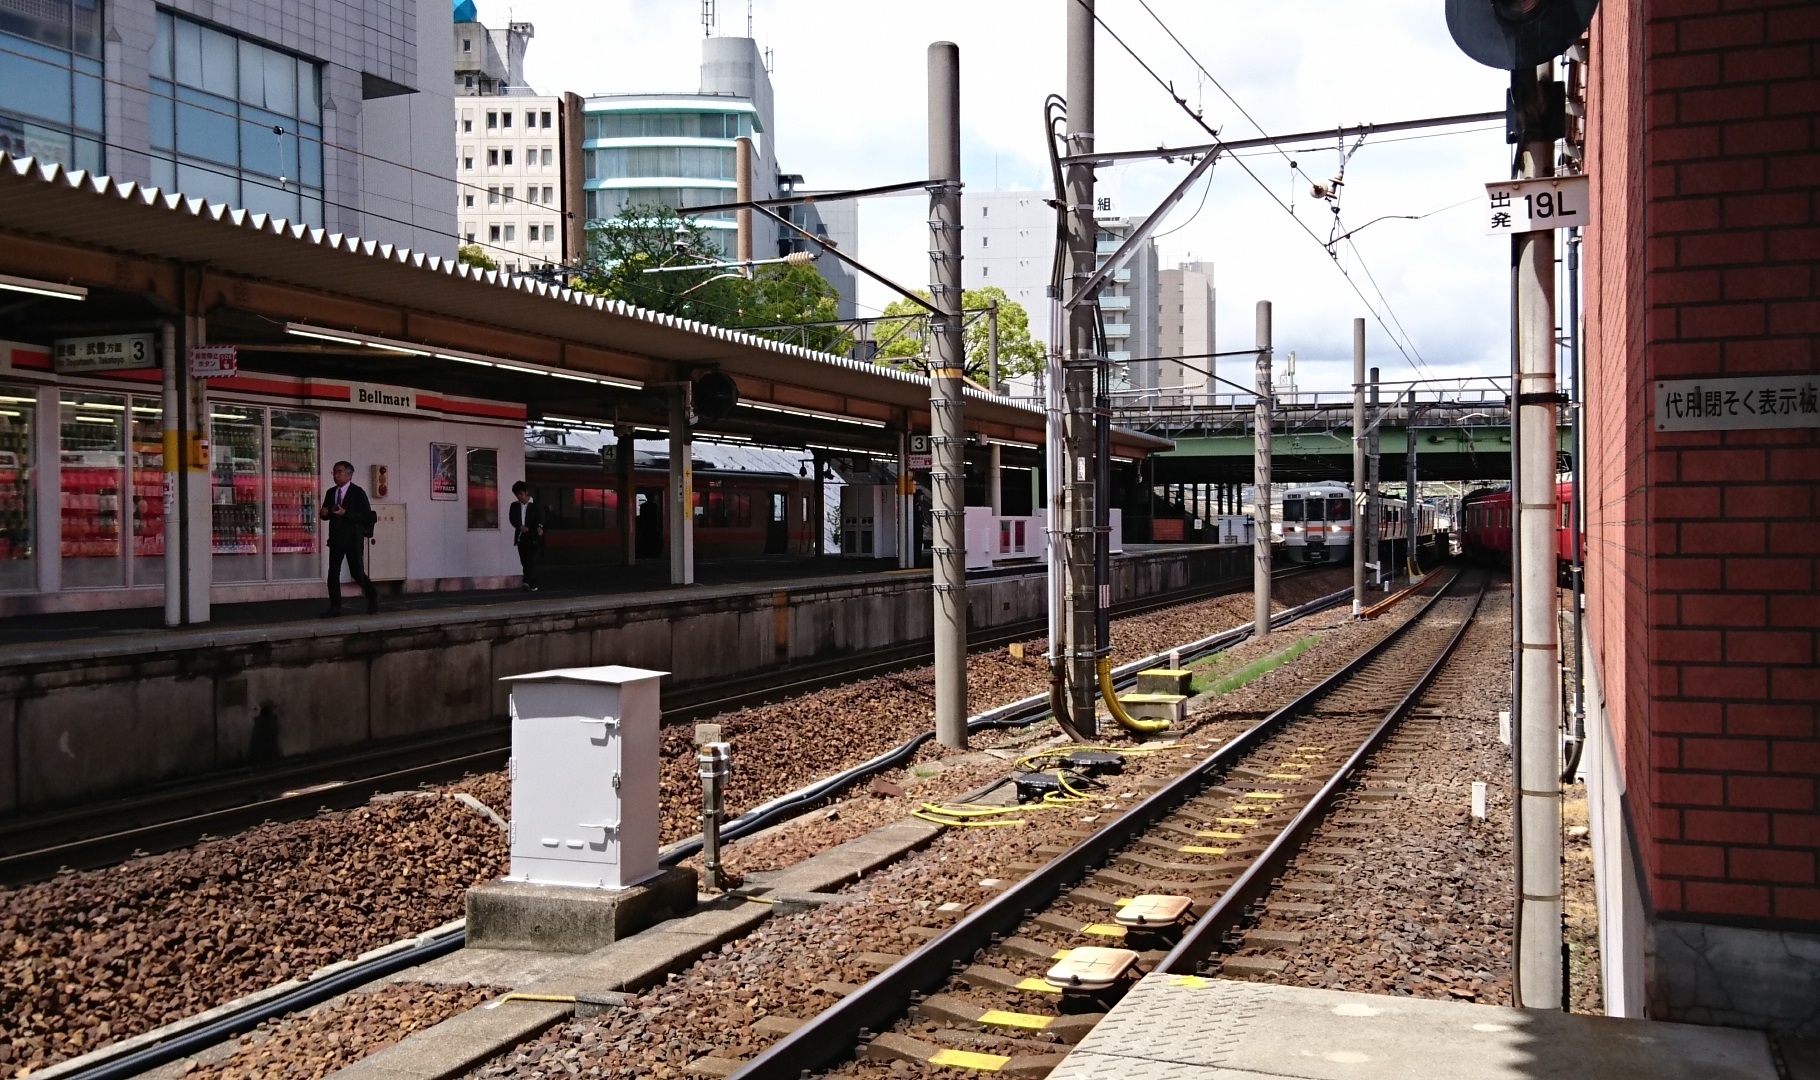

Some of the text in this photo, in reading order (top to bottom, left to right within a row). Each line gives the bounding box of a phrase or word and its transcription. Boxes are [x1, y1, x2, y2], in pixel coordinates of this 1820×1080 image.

[1096, 197, 1111, 212] 組
[1491, 191, 1511, 229] 出発
[1524, 191, 1577, 219] 19L
[132, 341, 145, 361] 3
[358, 388, 410, 407] Bellmart
[1665, 387, 1818, 418] 代用閉そく表示板
[605, 446, 614, 458] 4
[915, 437, 924, 450] 3
